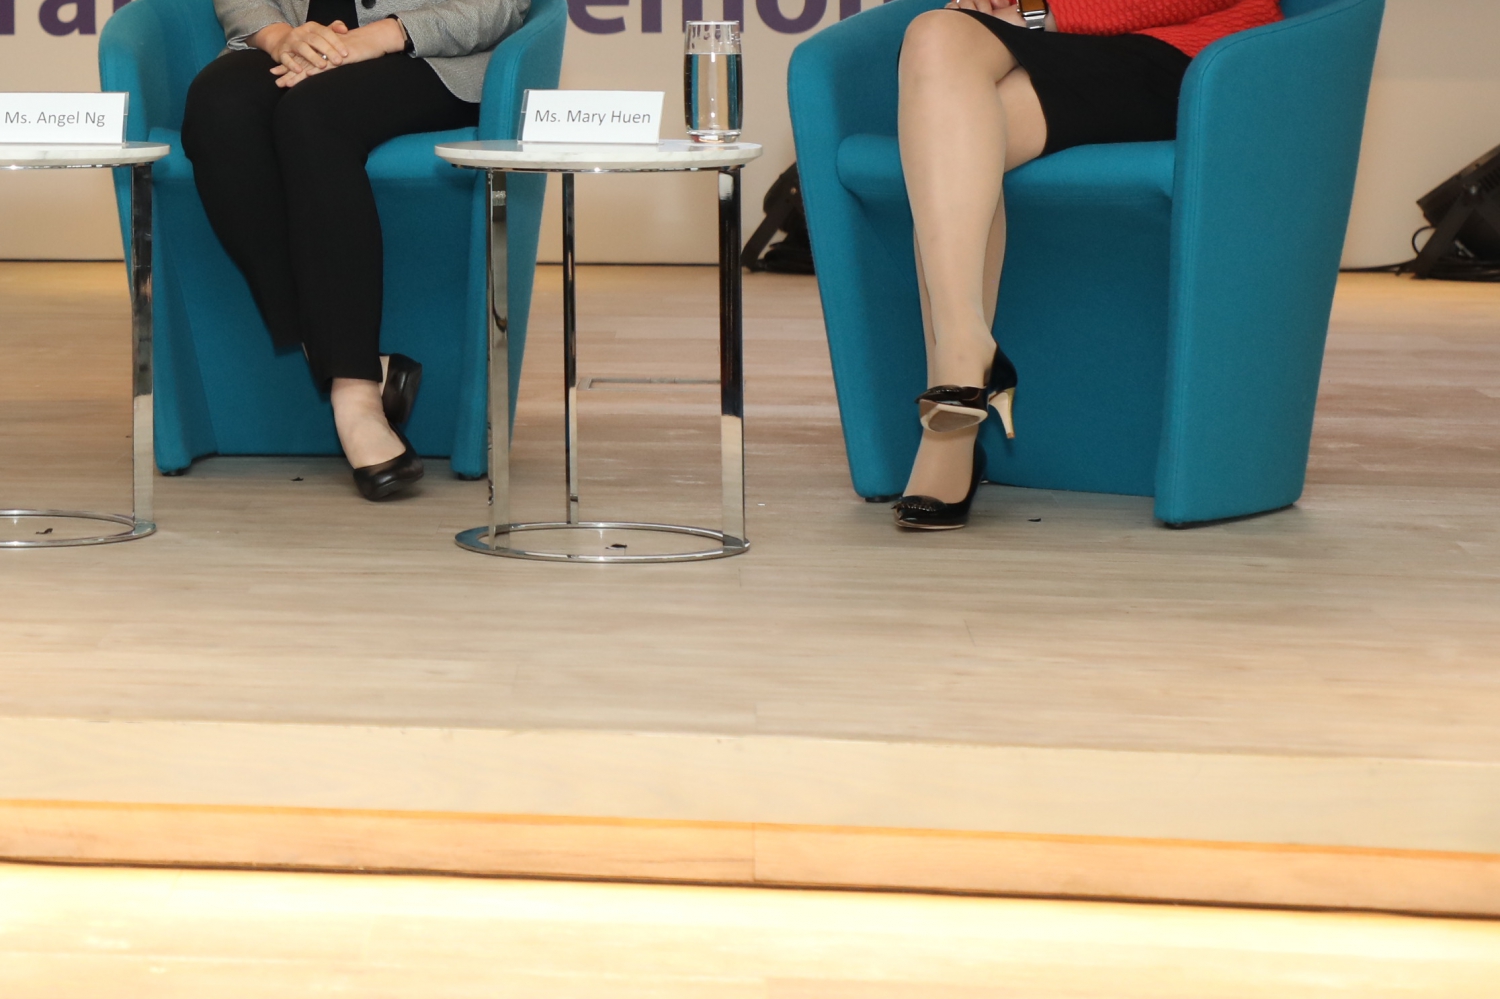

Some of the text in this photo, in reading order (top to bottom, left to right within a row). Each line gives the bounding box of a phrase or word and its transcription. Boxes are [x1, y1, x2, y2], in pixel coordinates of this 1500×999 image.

[4, 110, 106, 127] Ms. Angel Ng
[534, 109, 651, 126] Ms. Mary Huen
